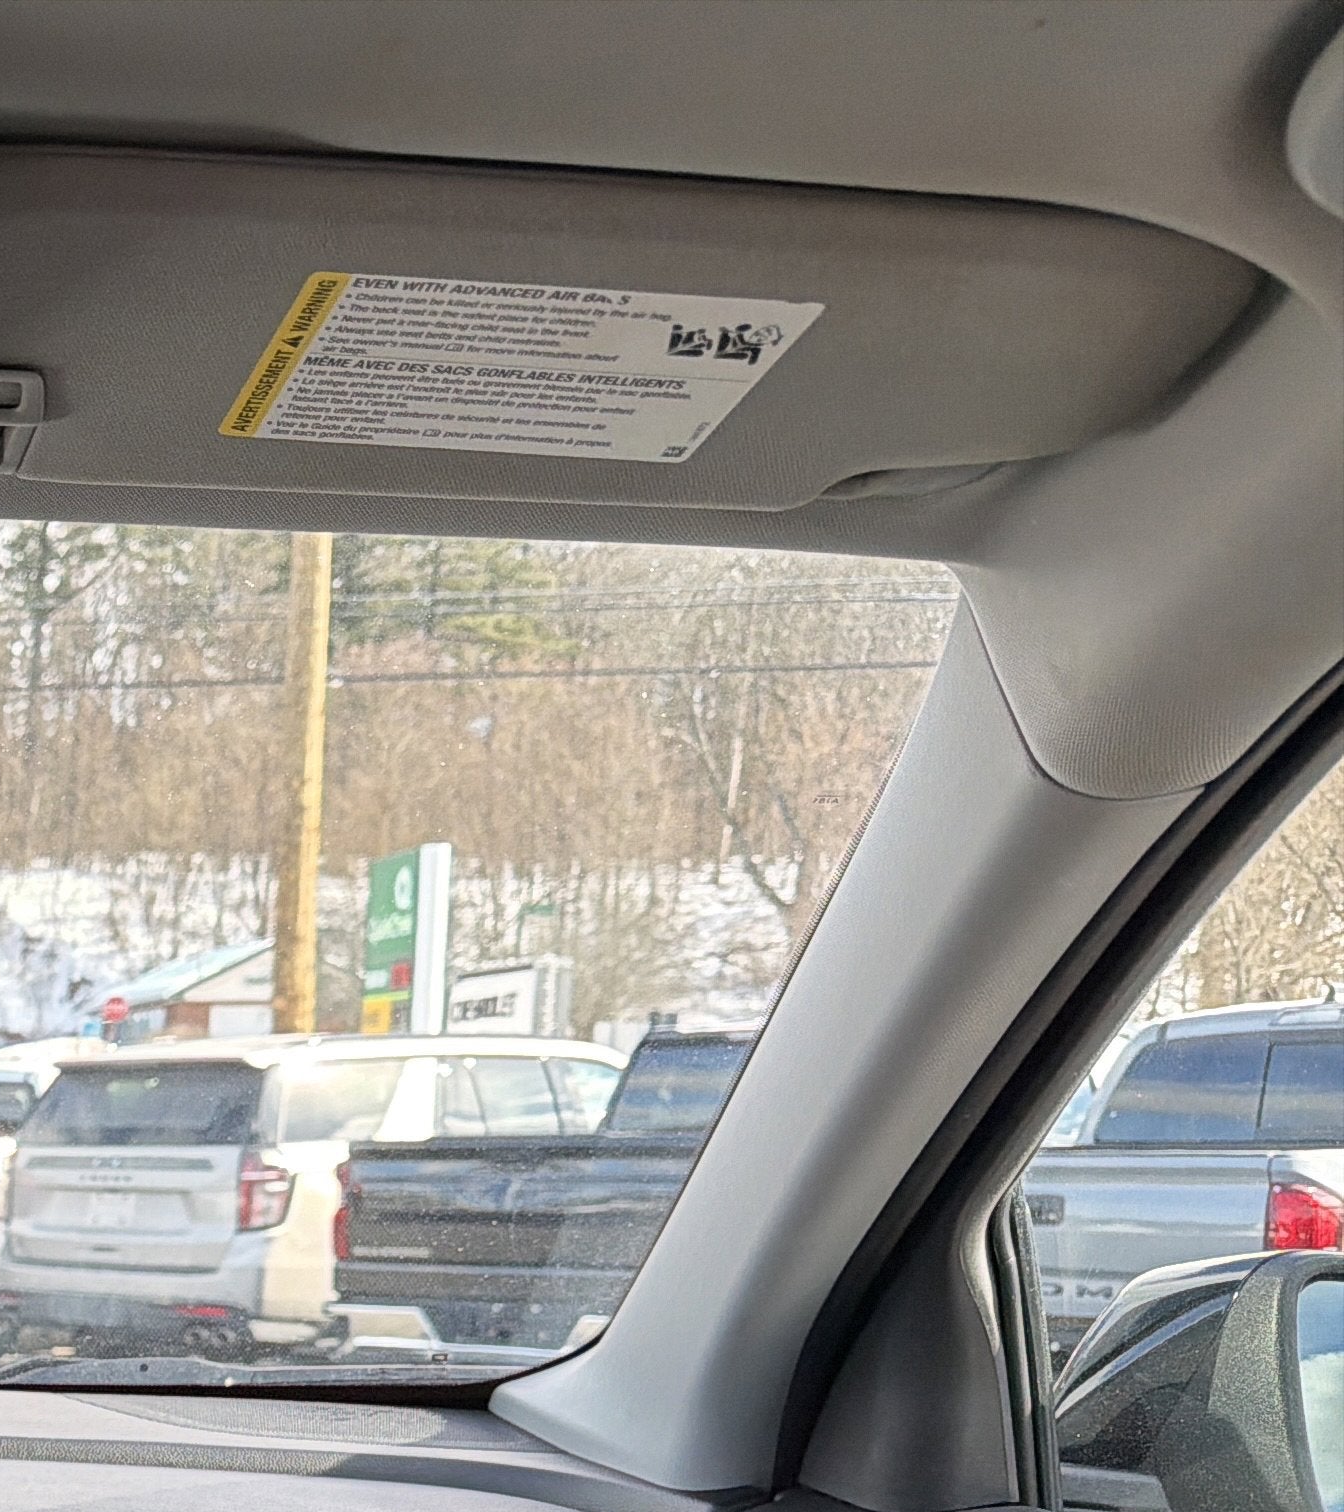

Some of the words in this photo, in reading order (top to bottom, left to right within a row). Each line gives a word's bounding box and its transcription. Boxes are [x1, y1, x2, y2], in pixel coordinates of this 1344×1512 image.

[352, 278, 397, 289] EVEN
[402, 280, 448, 293] WITH
[450, 283, 545, 299] ADVANCED
[548, 290, 580, 302] AIR
[355, 293, 401, 303] Children
[447, 299, 478, 308] killed
[290, 279, 337, 332] WARNING
[350, 304, 369, 312] The
[372, 305, 398, 314] back
[441, 309, 460, 317] the
[342, 315, 374, 324] Never
[376, 317, 397, 326] put
[303, 356, 352, 368] MÊME
[354, 360, 393, 371] AVEC
[398, 362, 432, 373] DES
[431, 364, 474, 376] SACS
[477, 368, 576, 383] GONFLABLES
[577, 374, 687, 390] INTELLIGENTS
[231, 349, 295, 432] AVERTISSEMENT
